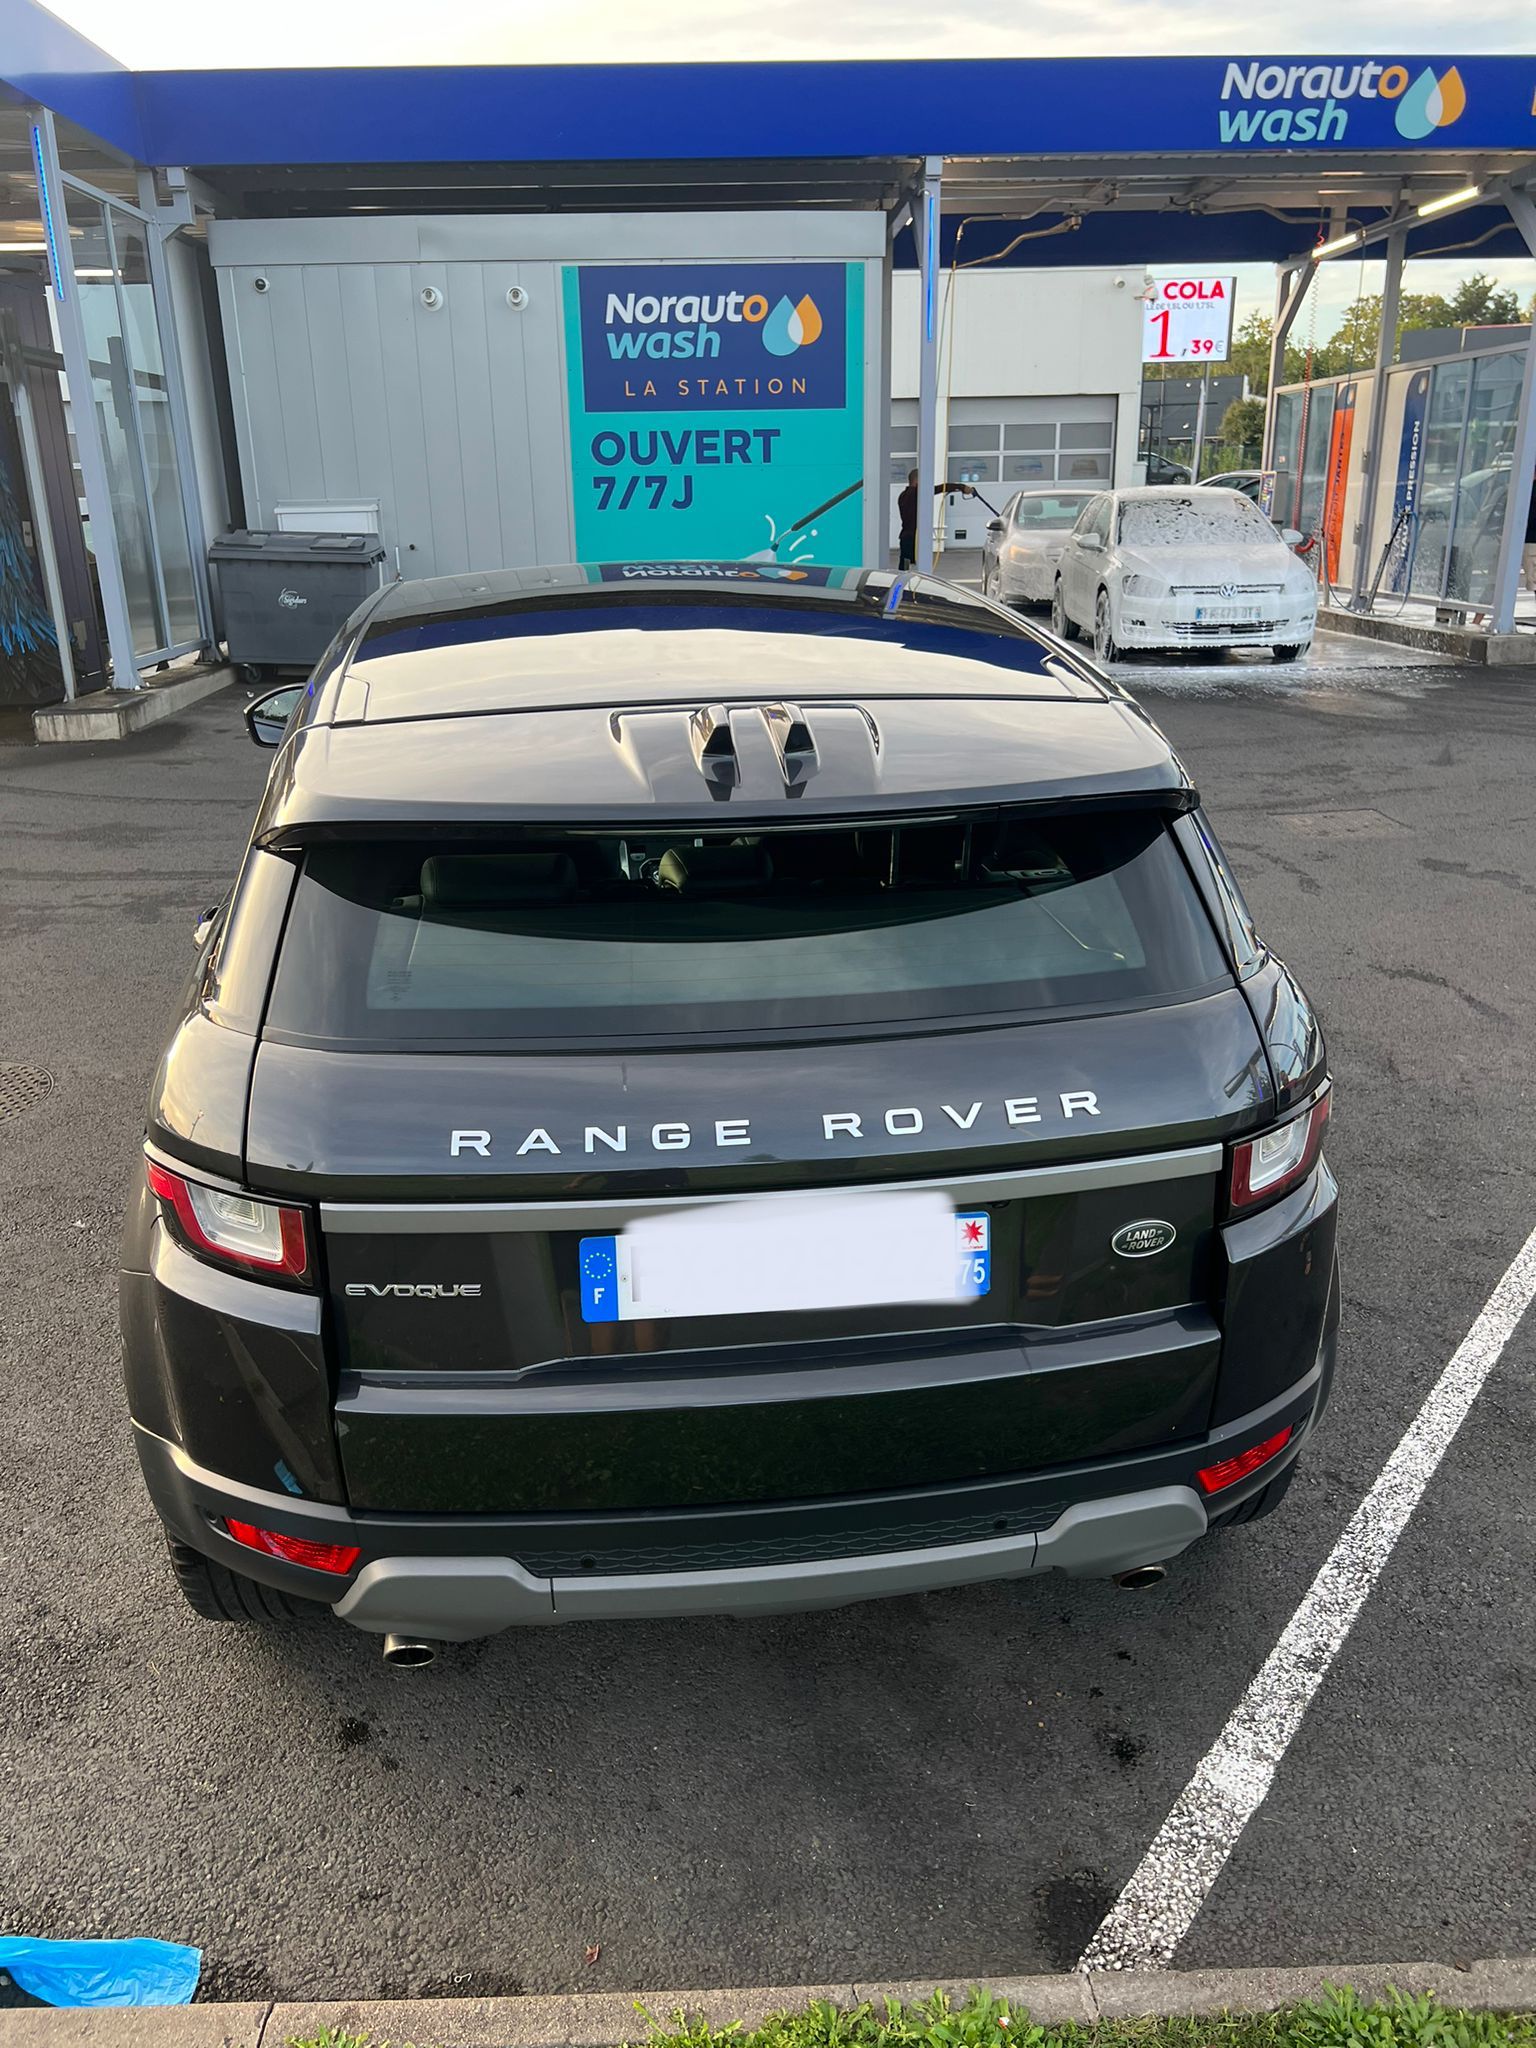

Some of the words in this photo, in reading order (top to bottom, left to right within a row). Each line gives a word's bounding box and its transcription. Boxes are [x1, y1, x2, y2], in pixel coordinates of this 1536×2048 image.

[1220, 61, 1409, 99] Norauto
[1219, 99, 1348, 142] wash
[605, 291, 768, 324] Norauto
[1163, 281, 1225, 300] COLA
[1182, 301, 1194, 309] OU
[606, 323, 721, 359] wash
[624, 380, 657, 397] LA
[677, 377, 807, 396] STATION
[591, 429, 781, 467] OUVERT
[1406, 420, 1421, 501] PRESSION
[592, 475, 694, 511] 7/7J
[450, 1119, 751, 1157] RANGE
[821, 1090, 1101, 1140] ROVER
[960, 1258, 986, 1285] 75
[345, 1283, 482, 1299] EVOQUE
[593, 1287, 605, 1306] F
